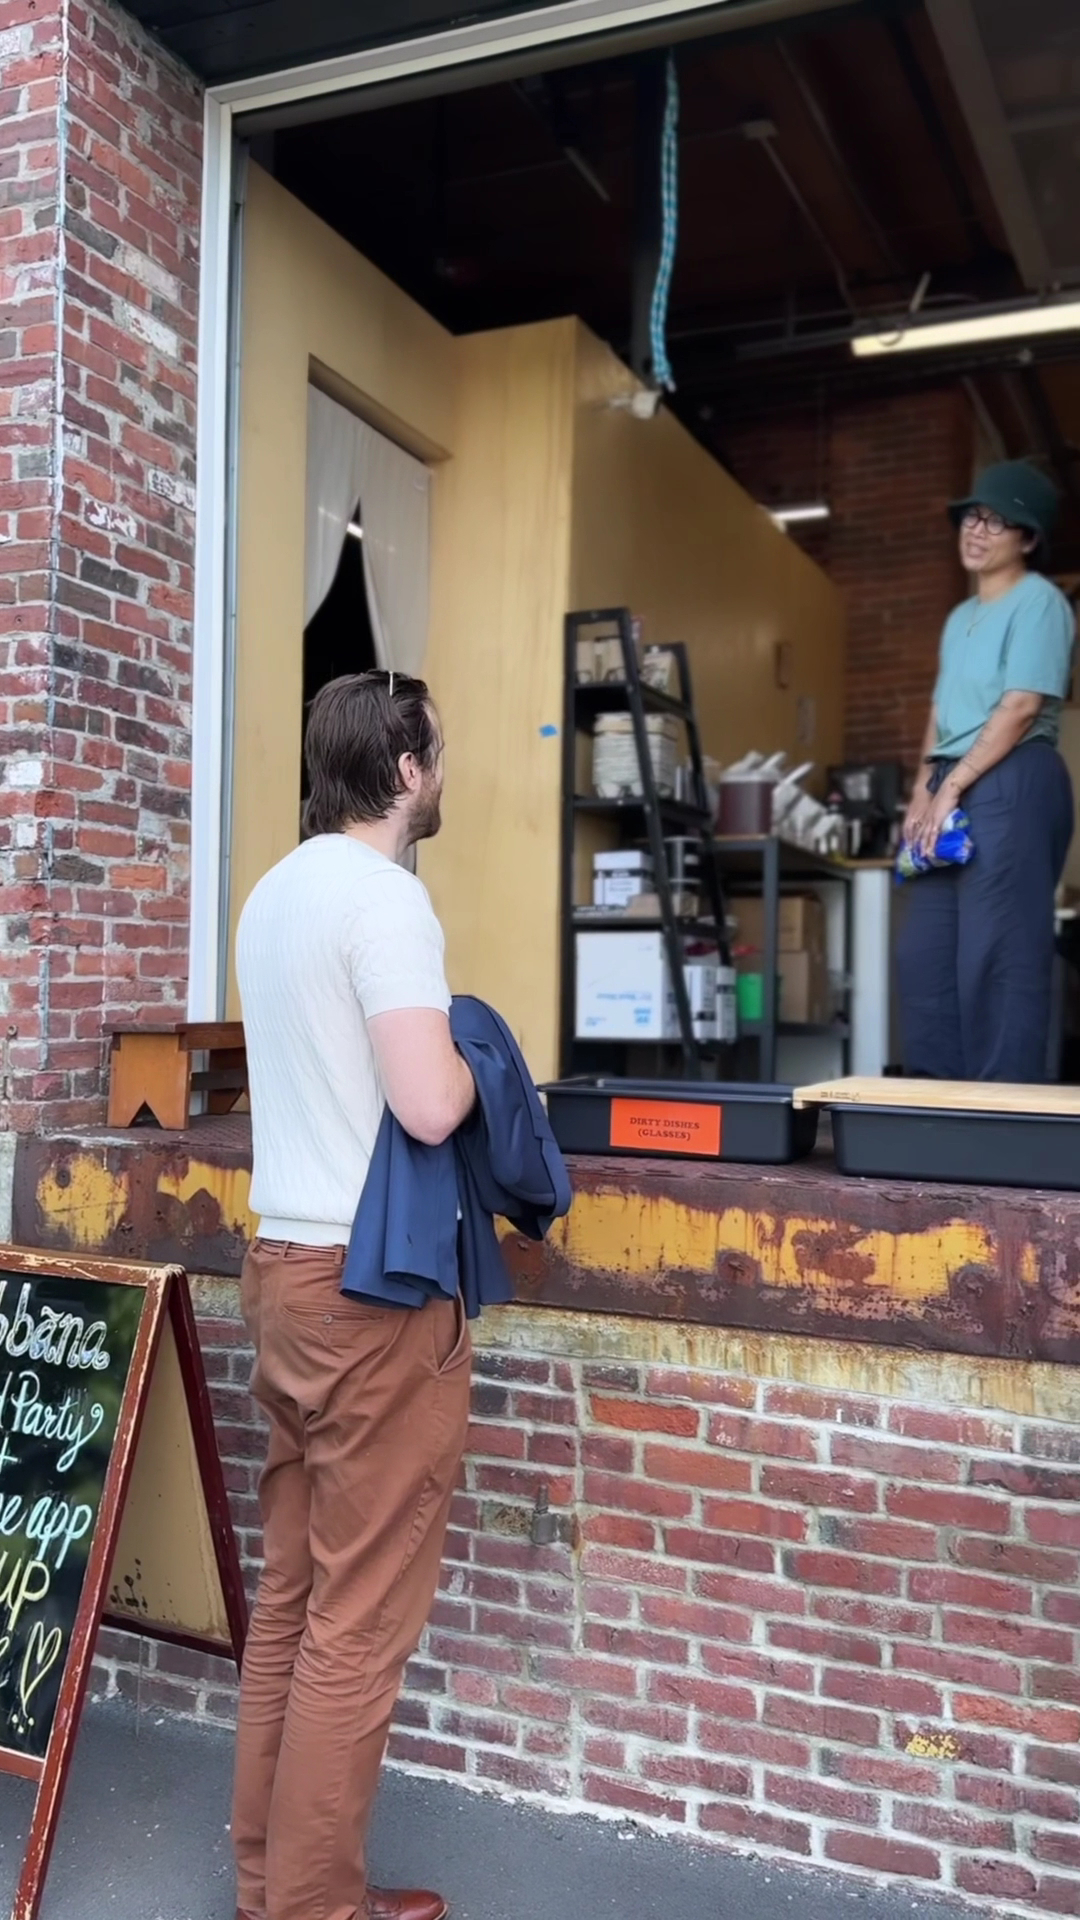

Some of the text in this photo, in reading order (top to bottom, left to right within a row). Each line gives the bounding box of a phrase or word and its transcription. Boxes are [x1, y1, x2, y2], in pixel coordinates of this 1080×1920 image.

[629, 1116, 700, 1130] DIRTY DISHES
[637, 1128, 691, 1141] (GLASSES)
[11, 1370, 104, 1472] Party
